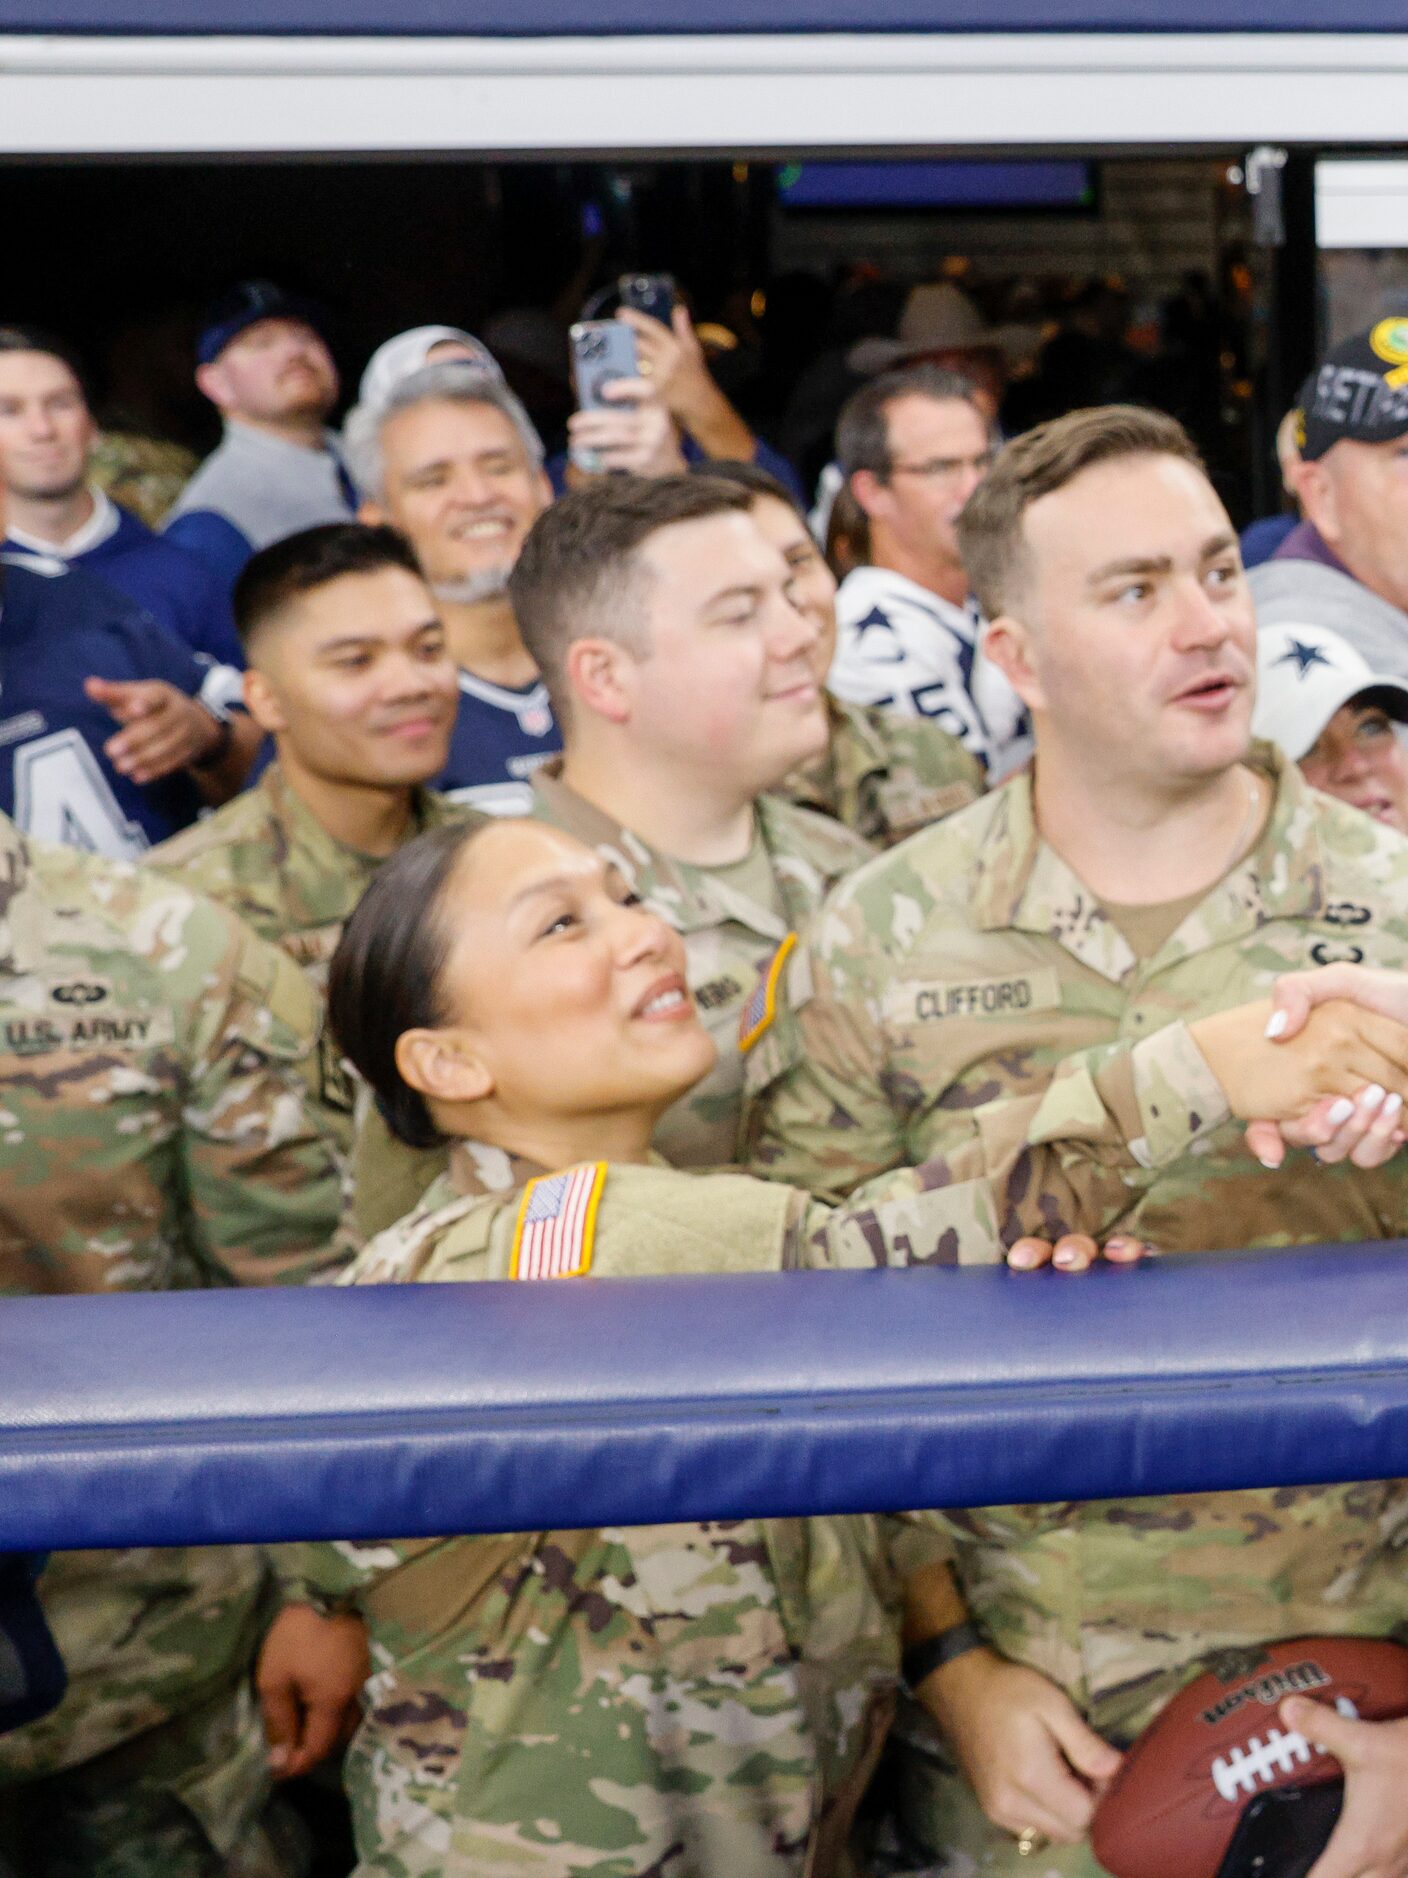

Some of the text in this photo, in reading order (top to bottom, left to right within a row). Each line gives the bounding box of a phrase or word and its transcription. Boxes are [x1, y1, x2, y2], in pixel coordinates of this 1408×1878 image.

[916, 979, 1032, 1020] CLIFFORD
[71, 1018, 150, 1042] ARMY
[1202, 1658, 1330, 1726] Wilson
